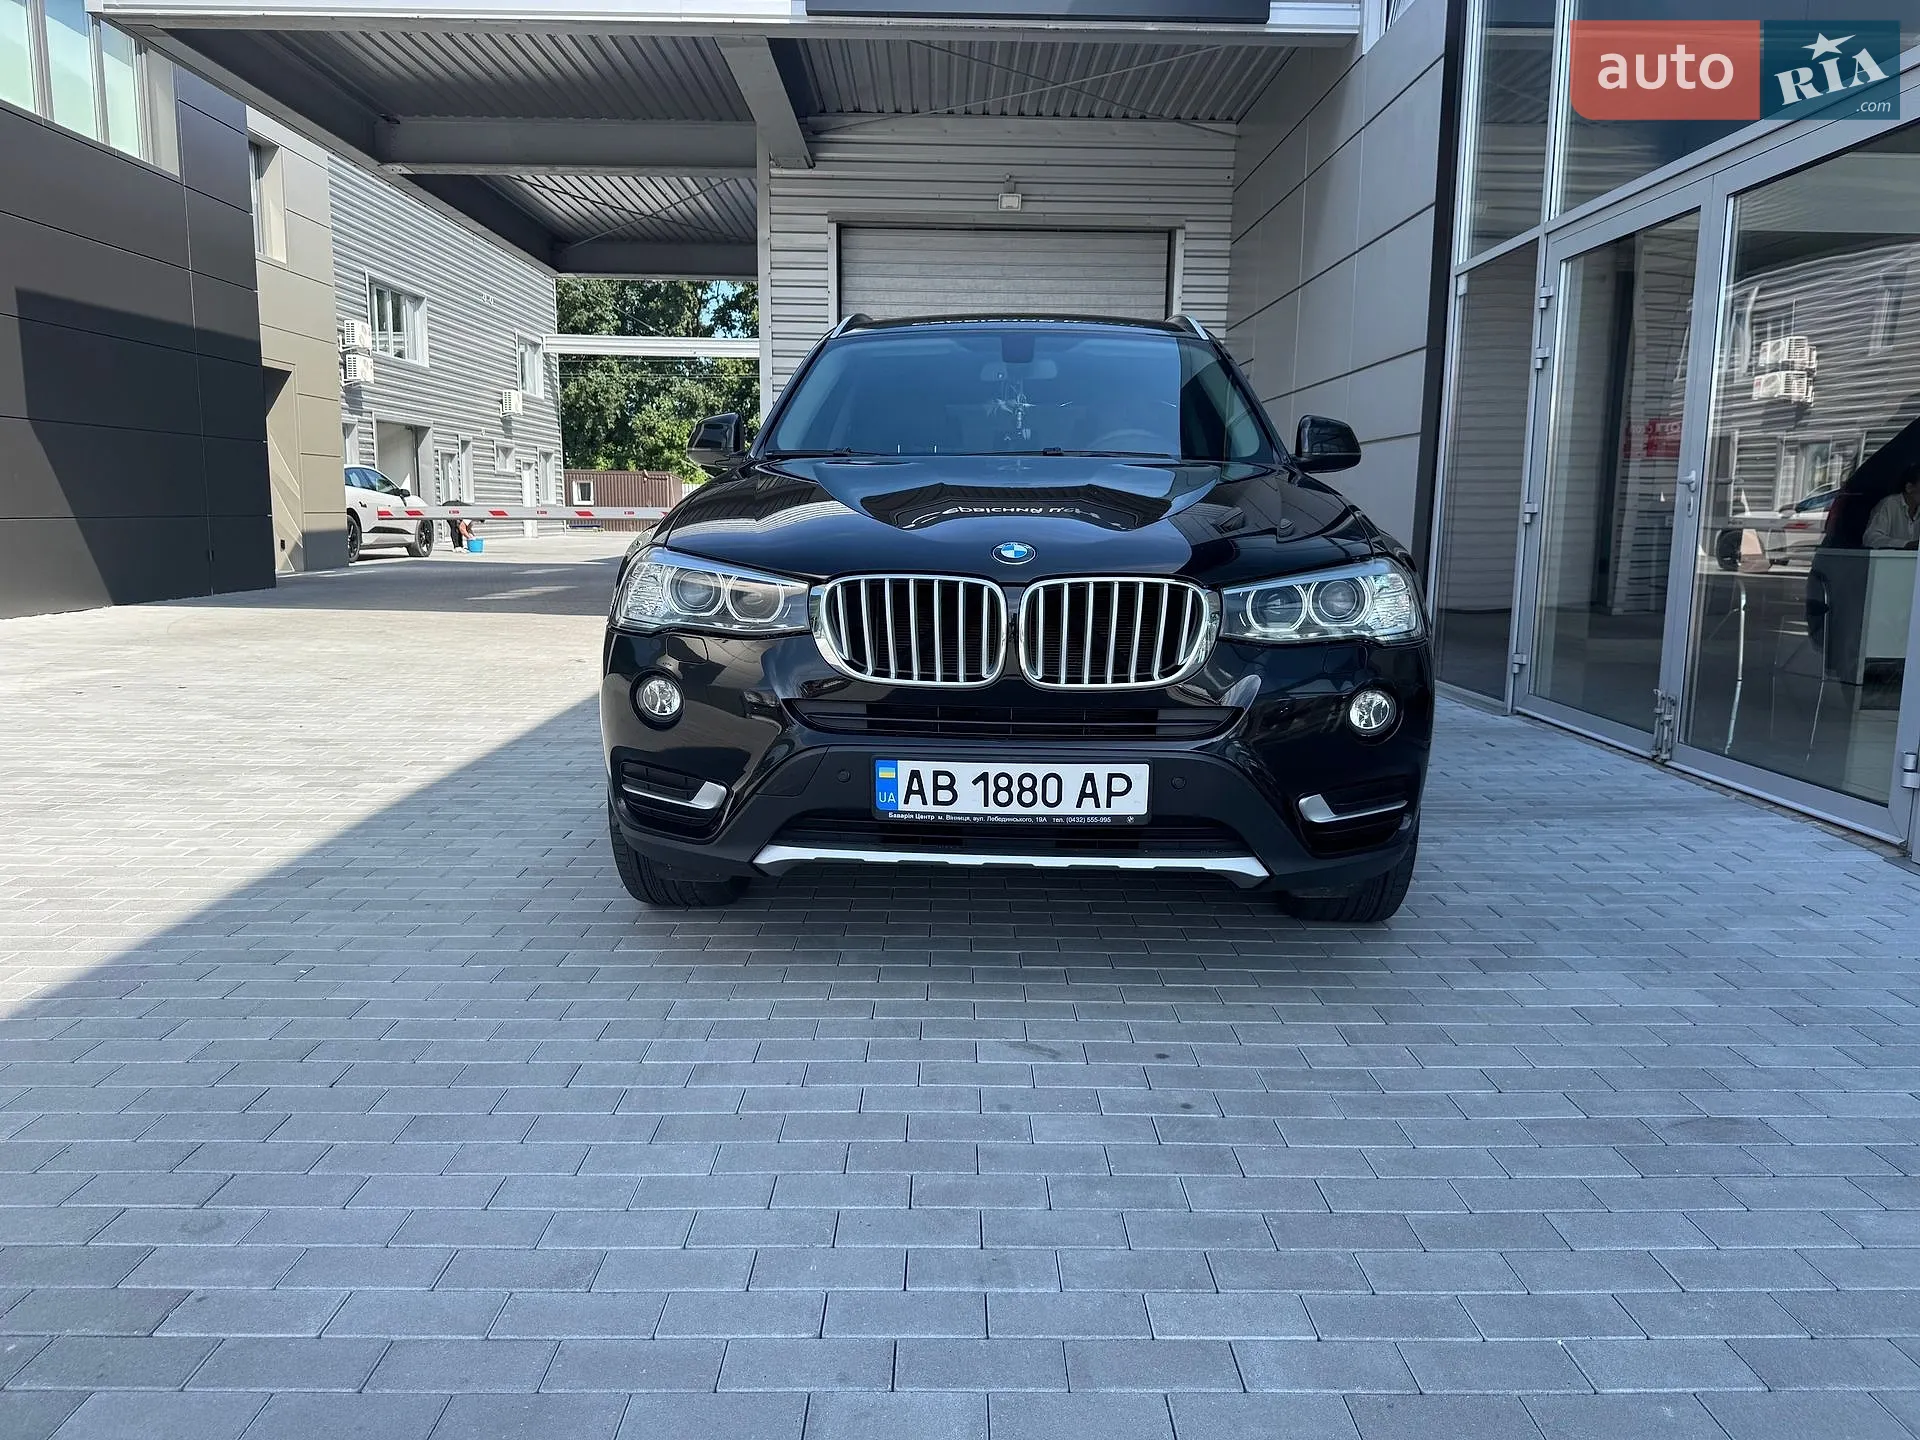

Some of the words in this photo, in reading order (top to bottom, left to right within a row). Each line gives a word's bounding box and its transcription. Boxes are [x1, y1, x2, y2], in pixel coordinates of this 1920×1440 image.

[903, 769, 959, 807] AB
[971, 771, 1063, 808] 1880
[1075, 772, 1133, 809] AP
[878, 791, 896, 804] UA
[915, 812, 935, 821] Центр
[1066, 816, 1086, 824] (0432)
